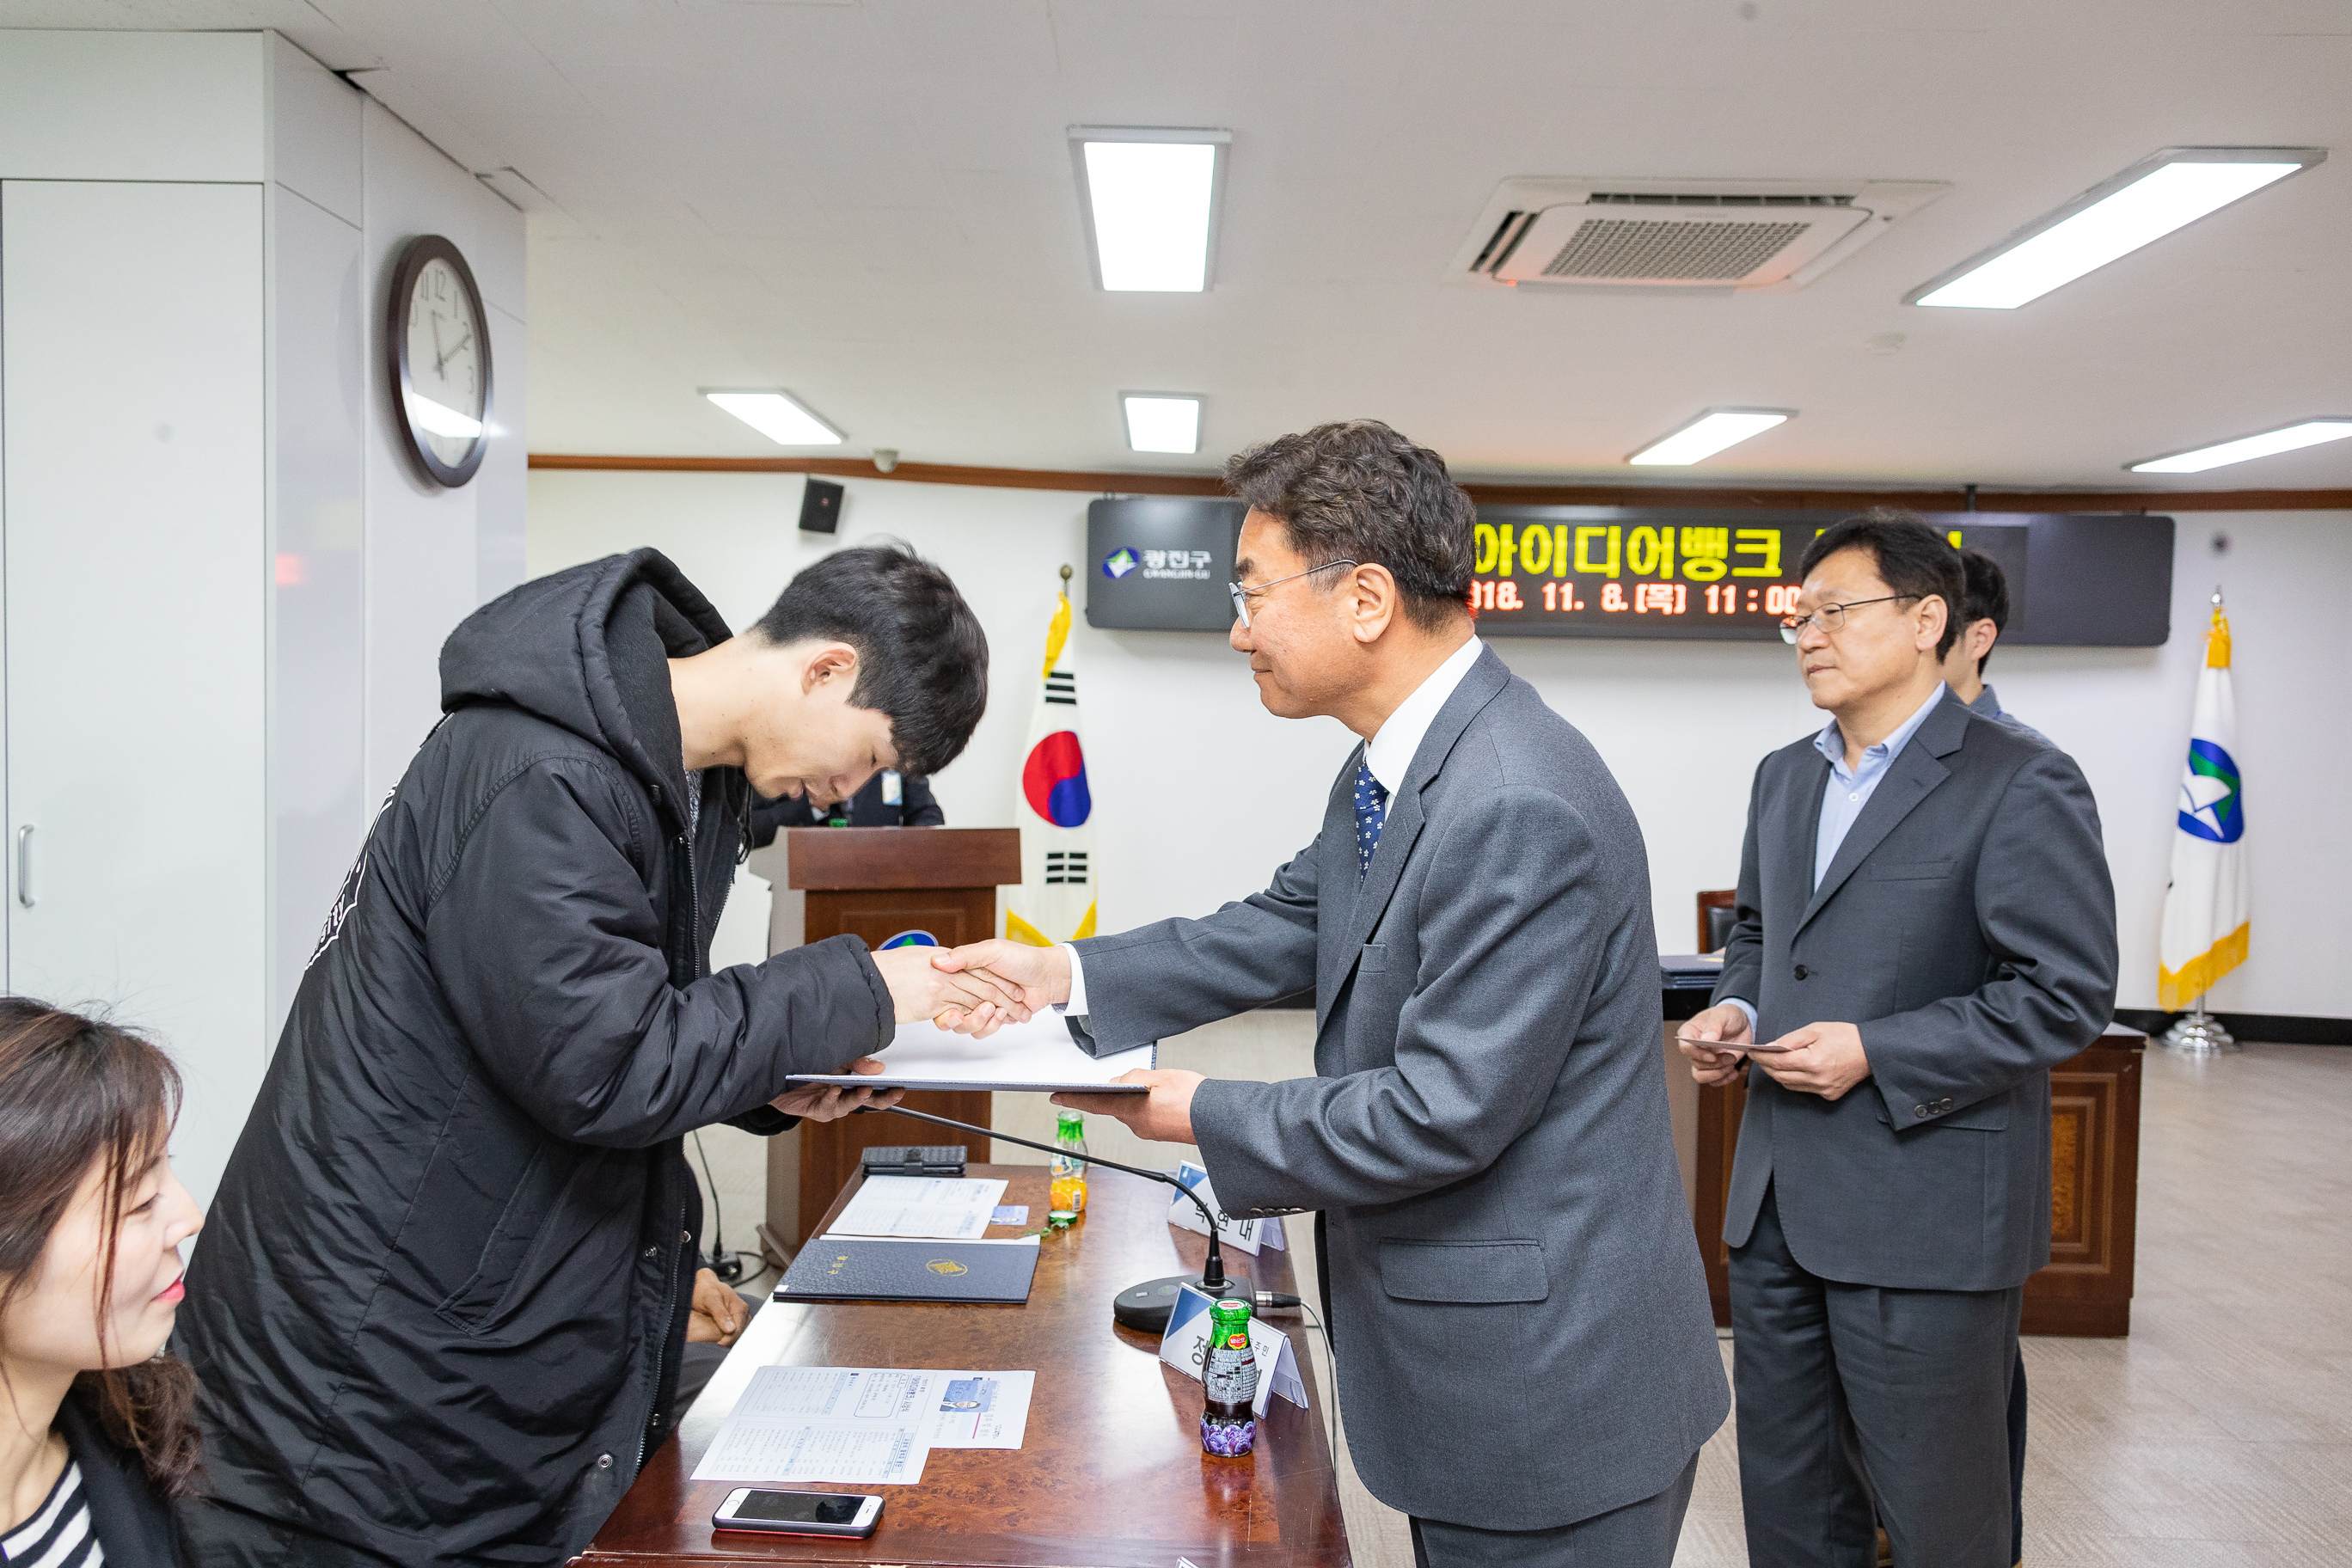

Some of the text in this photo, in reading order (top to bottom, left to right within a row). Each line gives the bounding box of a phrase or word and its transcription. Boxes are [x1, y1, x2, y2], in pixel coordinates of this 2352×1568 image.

[1142, 549, 1213, 569] 광진구
[1473, 523, 1783, 582] 아이디어뱅크
[1541, 581, 1585, 612] 11.
